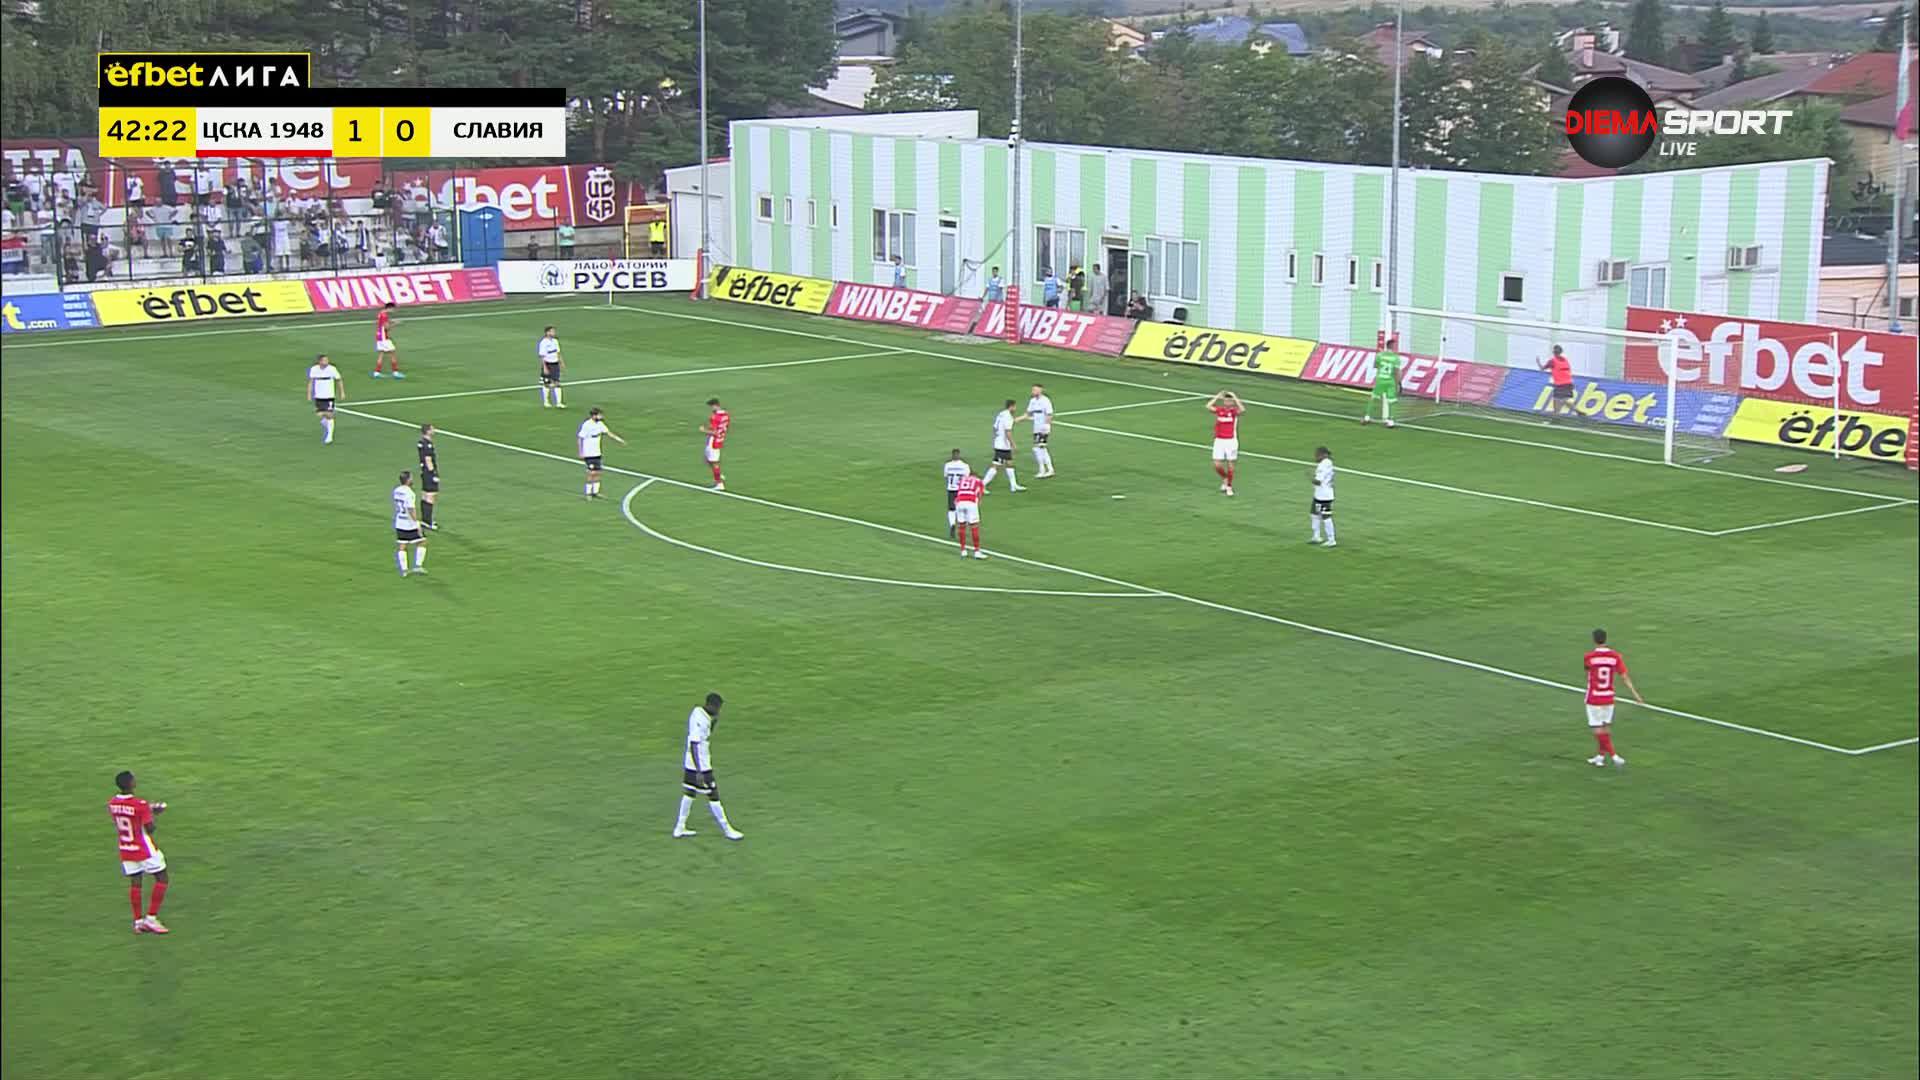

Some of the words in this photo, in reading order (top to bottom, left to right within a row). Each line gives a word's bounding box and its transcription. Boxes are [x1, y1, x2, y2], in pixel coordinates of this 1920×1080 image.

[314, 273, 454, 309] WINBET
[574, 271, 668, 290] РУСЕВ
[837, 284, 945, 325] WINBET
[984, 303, 1097, 347] WNBET
[1779, 409, 1907, 458] efbe
[1597, 666, 1611, 689] 9
